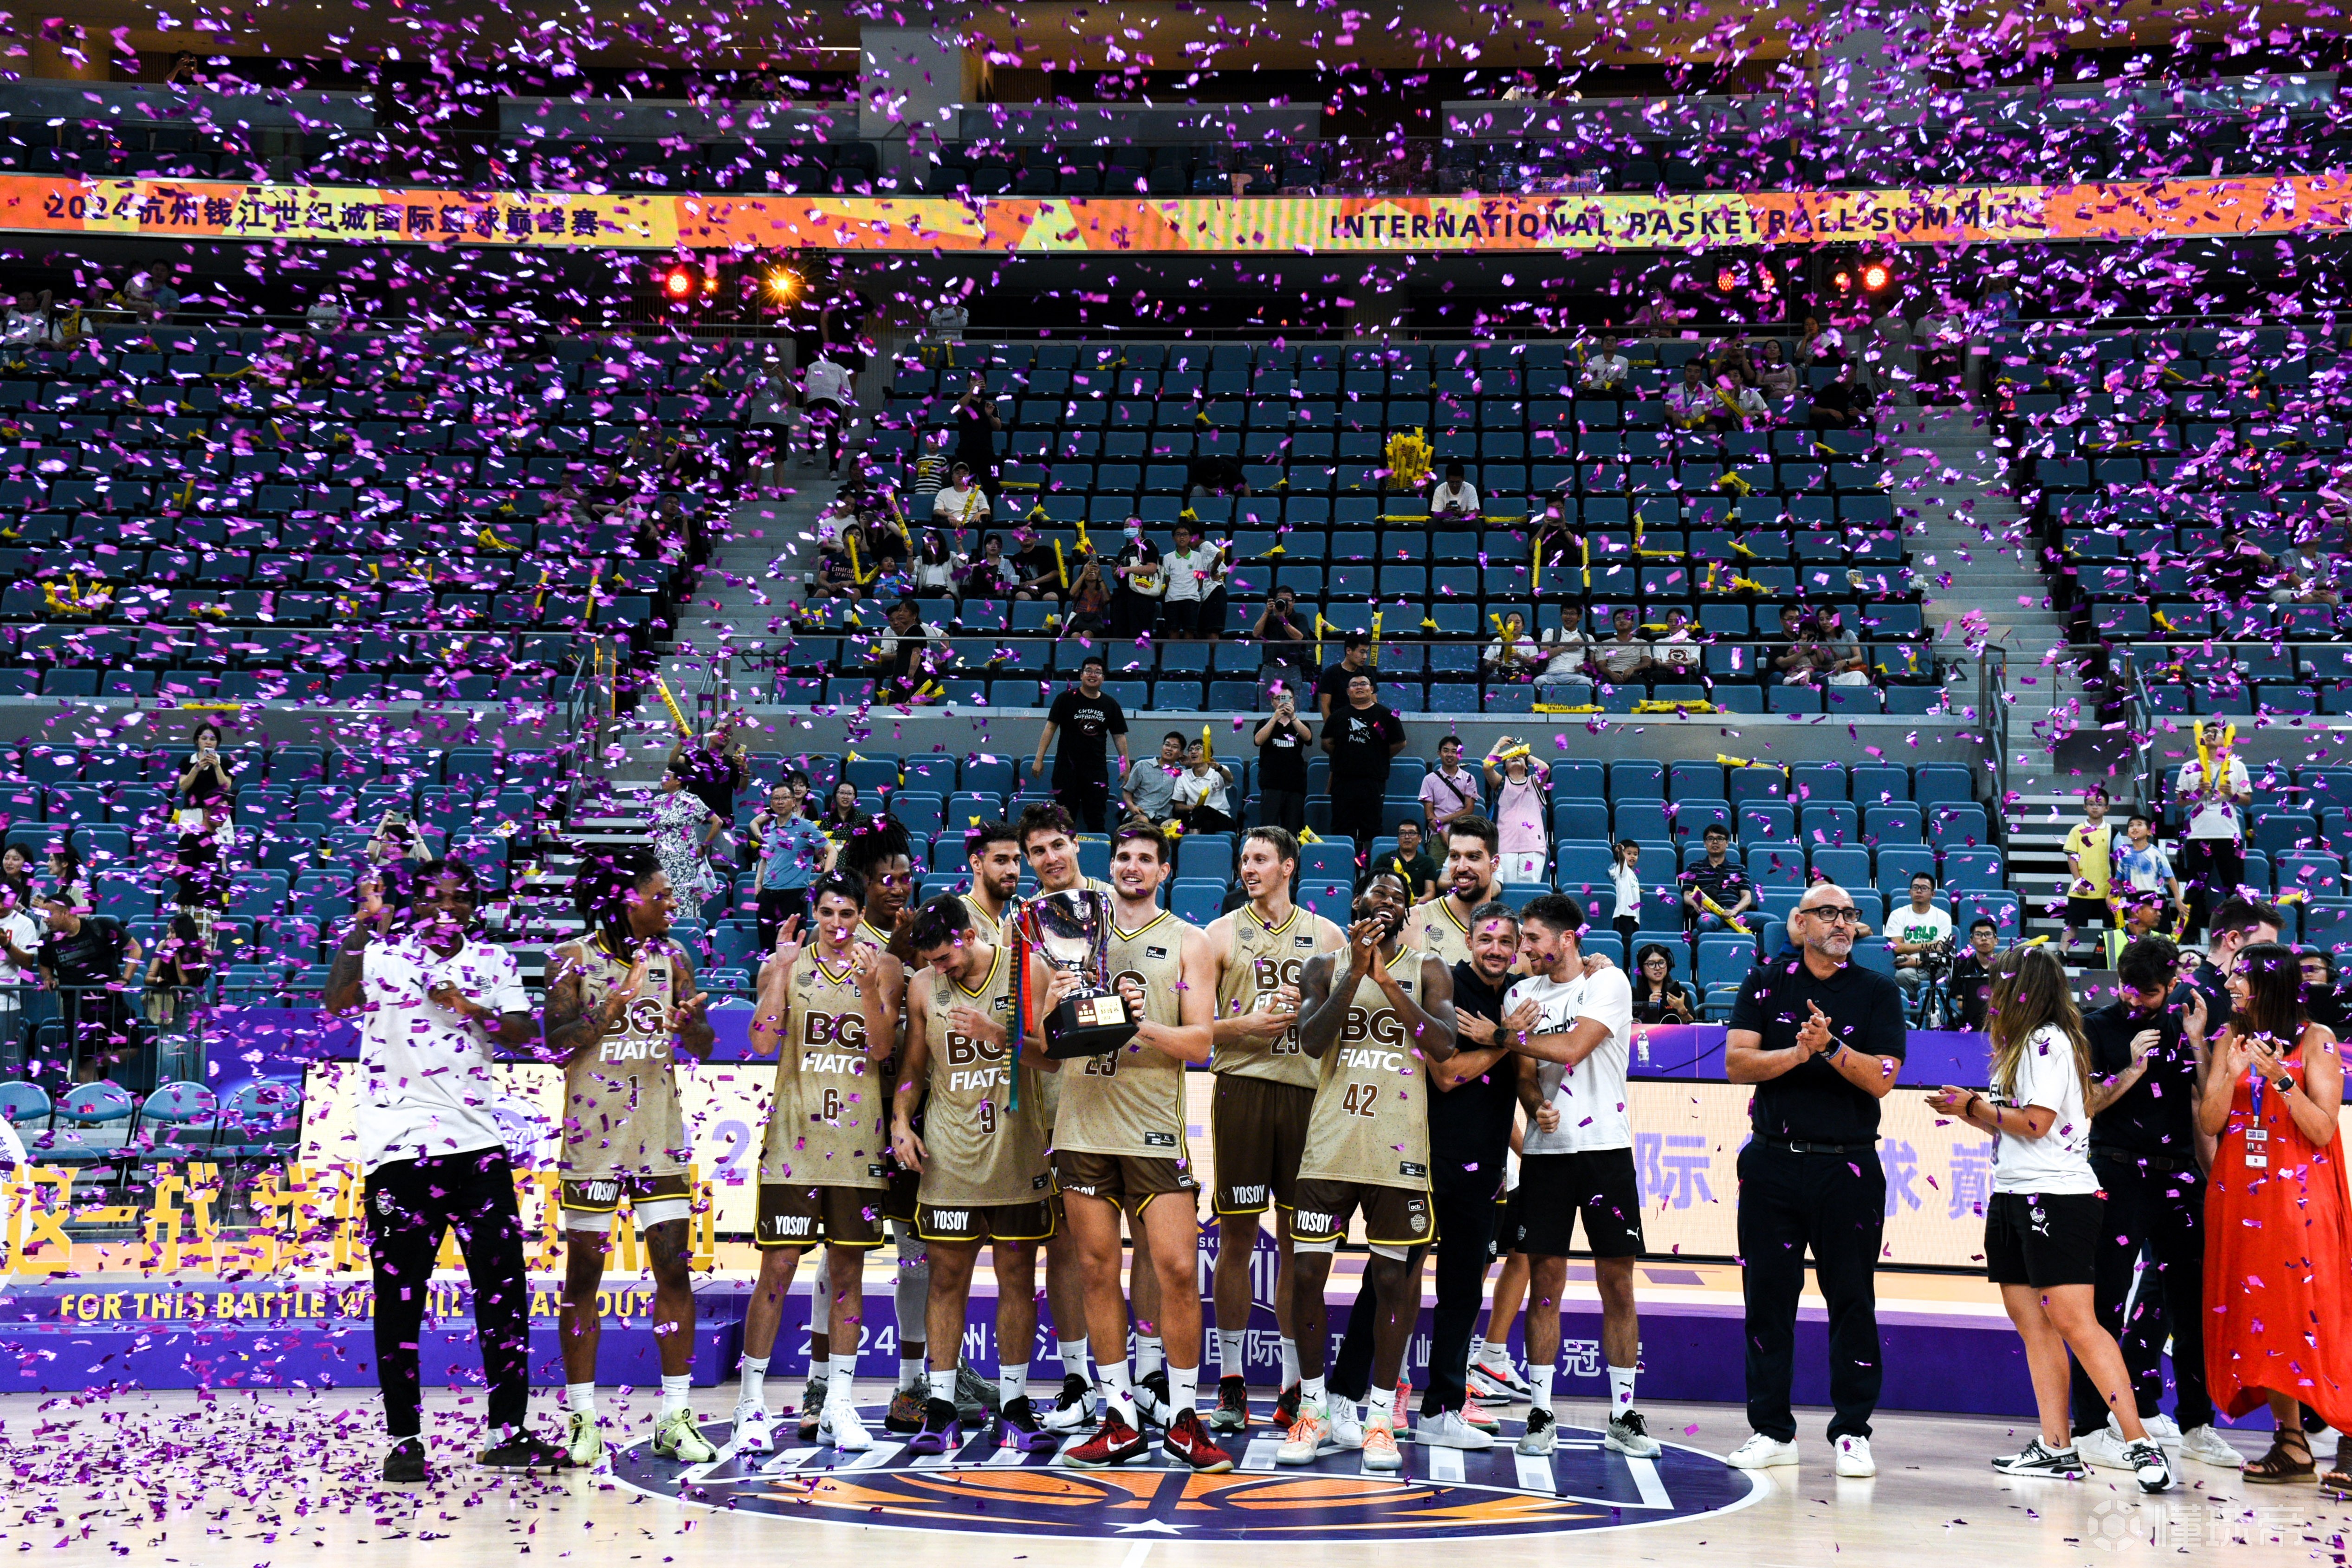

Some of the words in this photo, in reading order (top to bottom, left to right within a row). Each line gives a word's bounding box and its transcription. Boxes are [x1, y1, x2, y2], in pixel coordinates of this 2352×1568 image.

[1331, 212, 1608, 239] INTERNATIONAL
[1631, 209, 1855, 236] BASKETBALL
[1272, 739, 1295, 747] PUMA
[1348, 734, 1366, 743] PLANE
[803, 1010, 866, 1050] BG
[1340, 1005, 1406, 1048] BG
[1270, 1023, 1299, 1055] 29
[599, 1040, 667, 1062] FIATC
[1337, 1049, 1403, 1072] FIATC
[800, 1053, 867, 1075] FIATC
[823, 1088, 839, 1120] 6
[1341, 1082, 1379, 1118] 42
[979, 1101, 997, 1134] 9
[587, 1181, 620, 1201] YOSOY
[1232, 1185, 1265, 1205] YOSOY
[384, 1226, 390, 1237] 2
[775, 1215, 811, 1236] YOSOY
[933, 1210, 969, 1231] YOSOY
[1297, 1210, 1333, 1233] YOSOY
[61, 1293, 122, 1320] FOR
[134, 1293, 205, 1319] THIS
[217, 1292, 325, 1319] BATTLE
